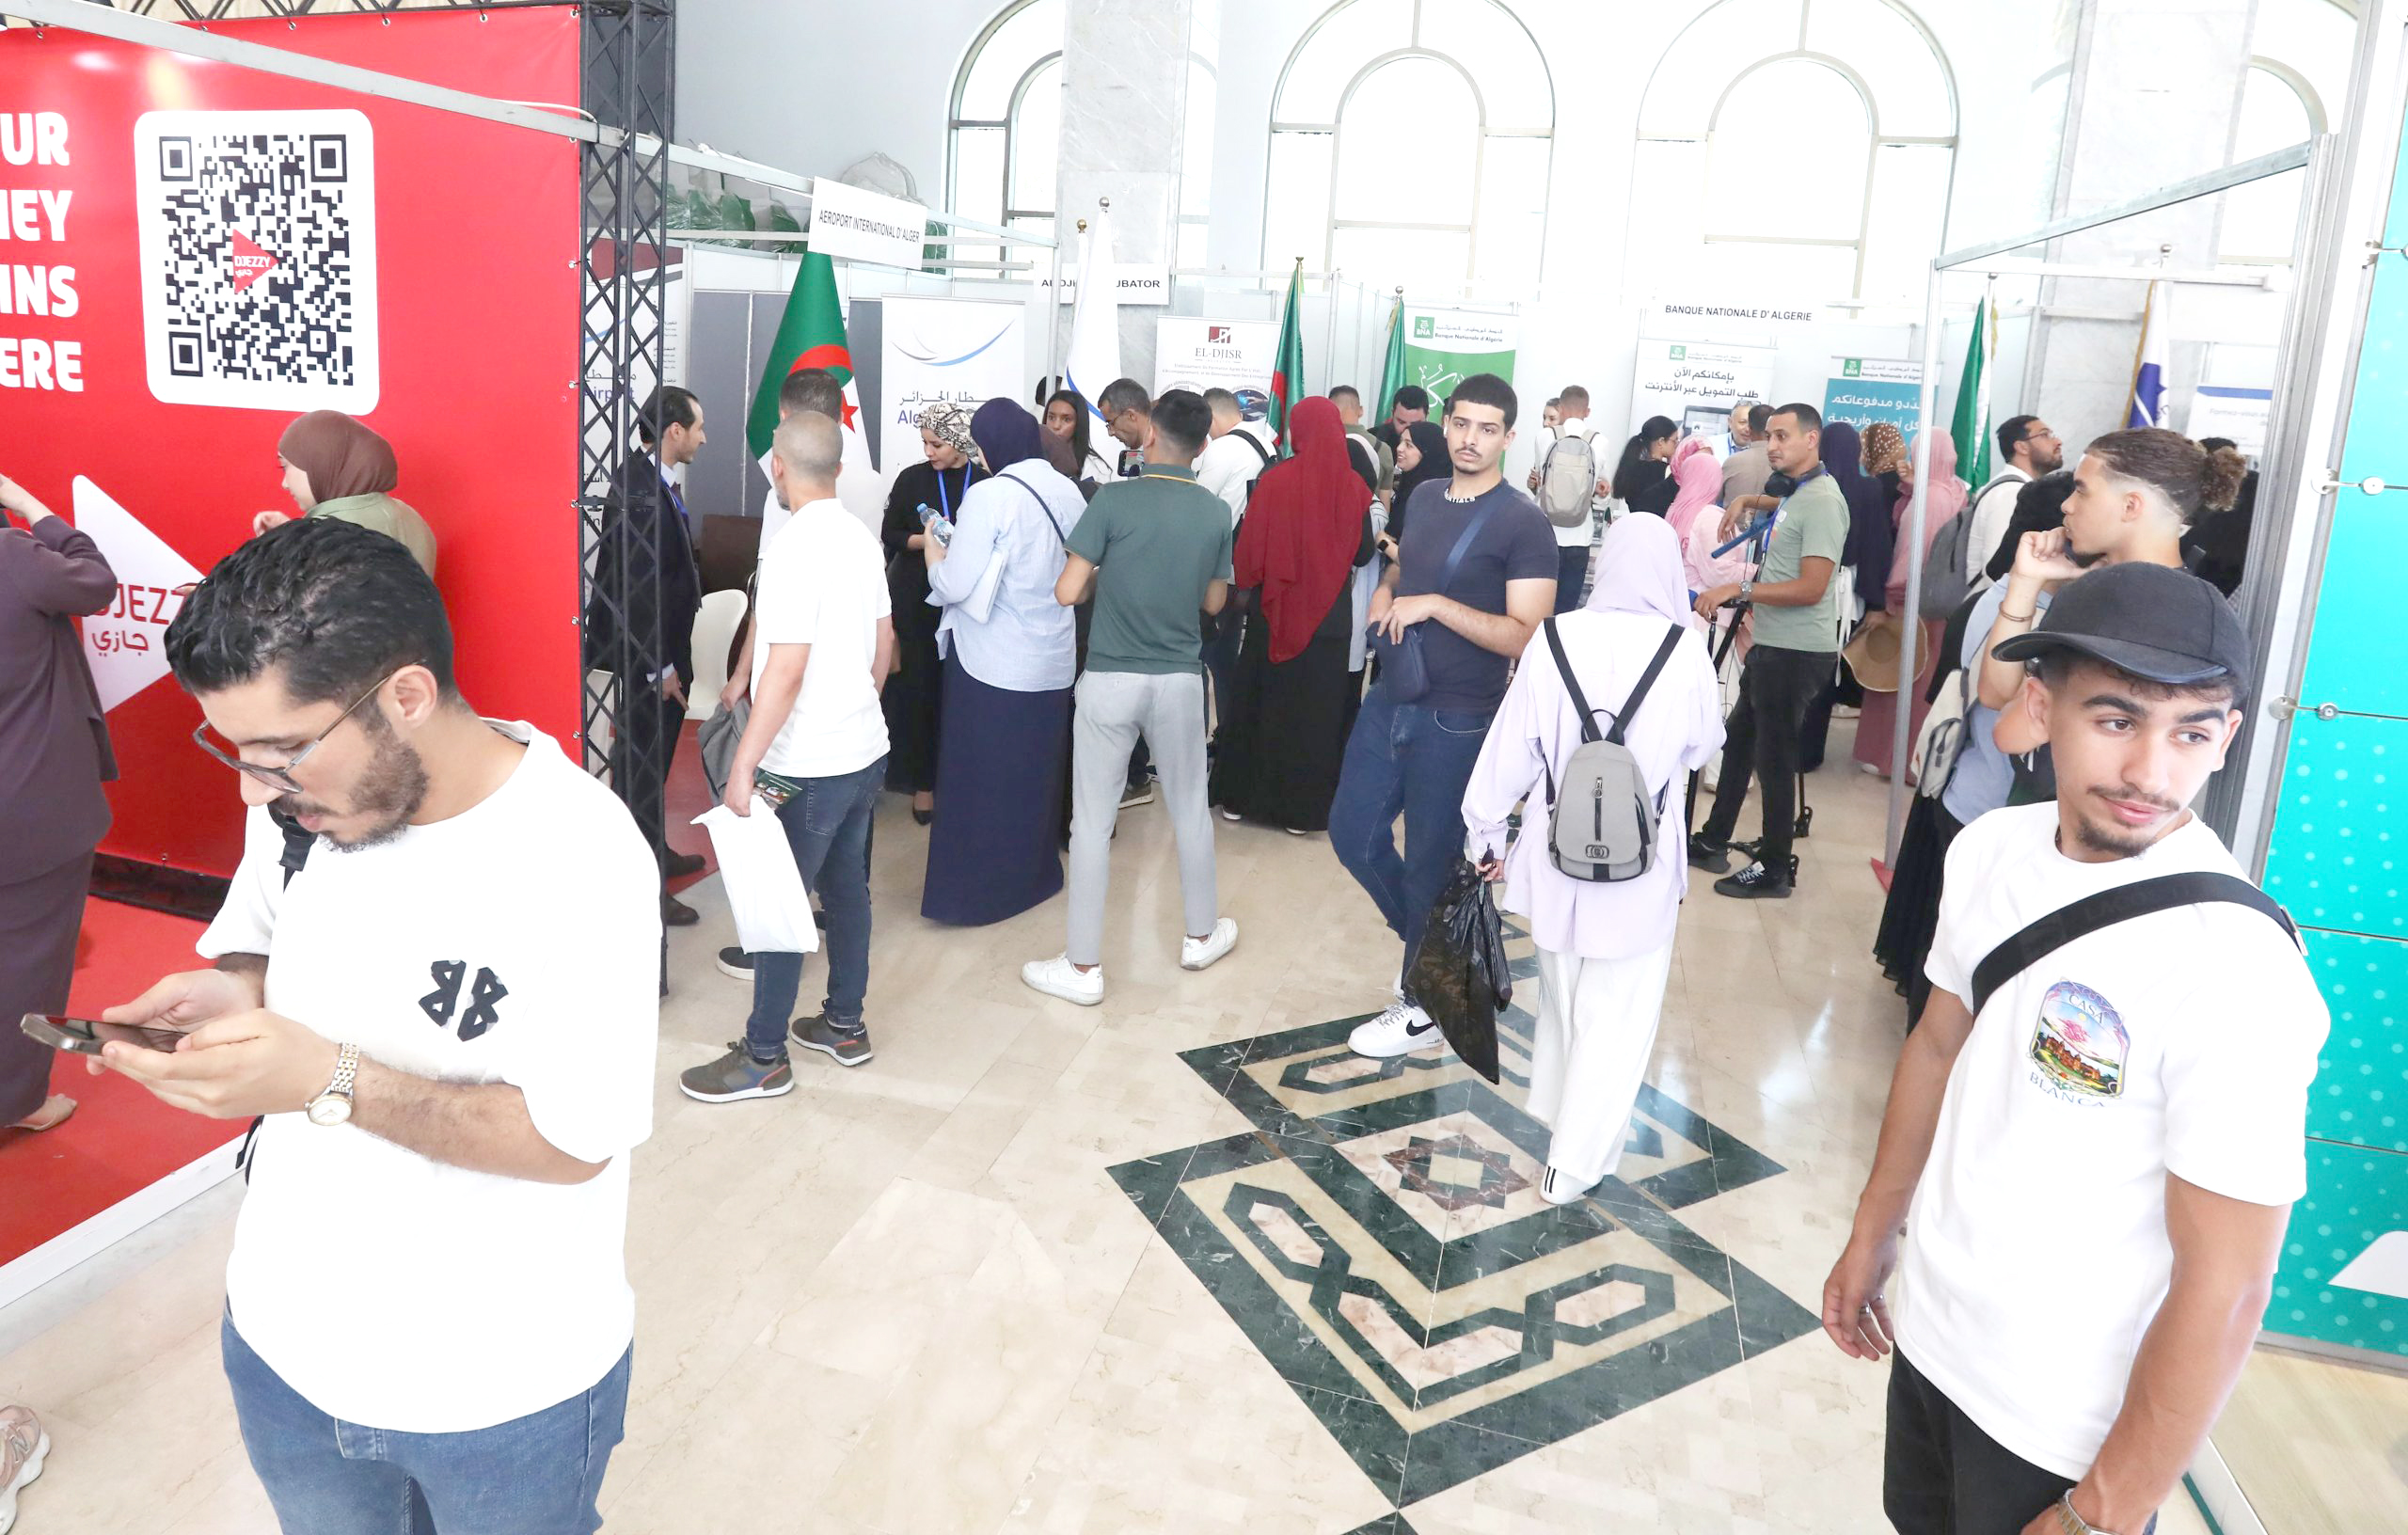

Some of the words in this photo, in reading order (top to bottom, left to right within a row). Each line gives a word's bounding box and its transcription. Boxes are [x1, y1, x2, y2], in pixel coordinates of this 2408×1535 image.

[818, 209, 852, 229] AEROPORT
[853, 217, 895, 239] INTERNATIONAL
[902, 229, 920, 244] ALGER
[234, 255, 270, 268] DJEZZY
[1665, 305, 1703, 315] BANQUE
[1705, 307, 1758, 318] NATIONALE
[1770, 310, 1813, 321] ALGERIE
[1692, 370, 1735, 384] بإمكانكم
[1683, 386, 1697, 395] عبر
[1699, 386, 1735, 398] التمويل
[1737, 389, 1759, 400] طلب
[92, 630, 149, 657] جازي
[2068, 994, 2104, 1024] CASA
[2030, 1071, 2105, 1107] BLANCA
